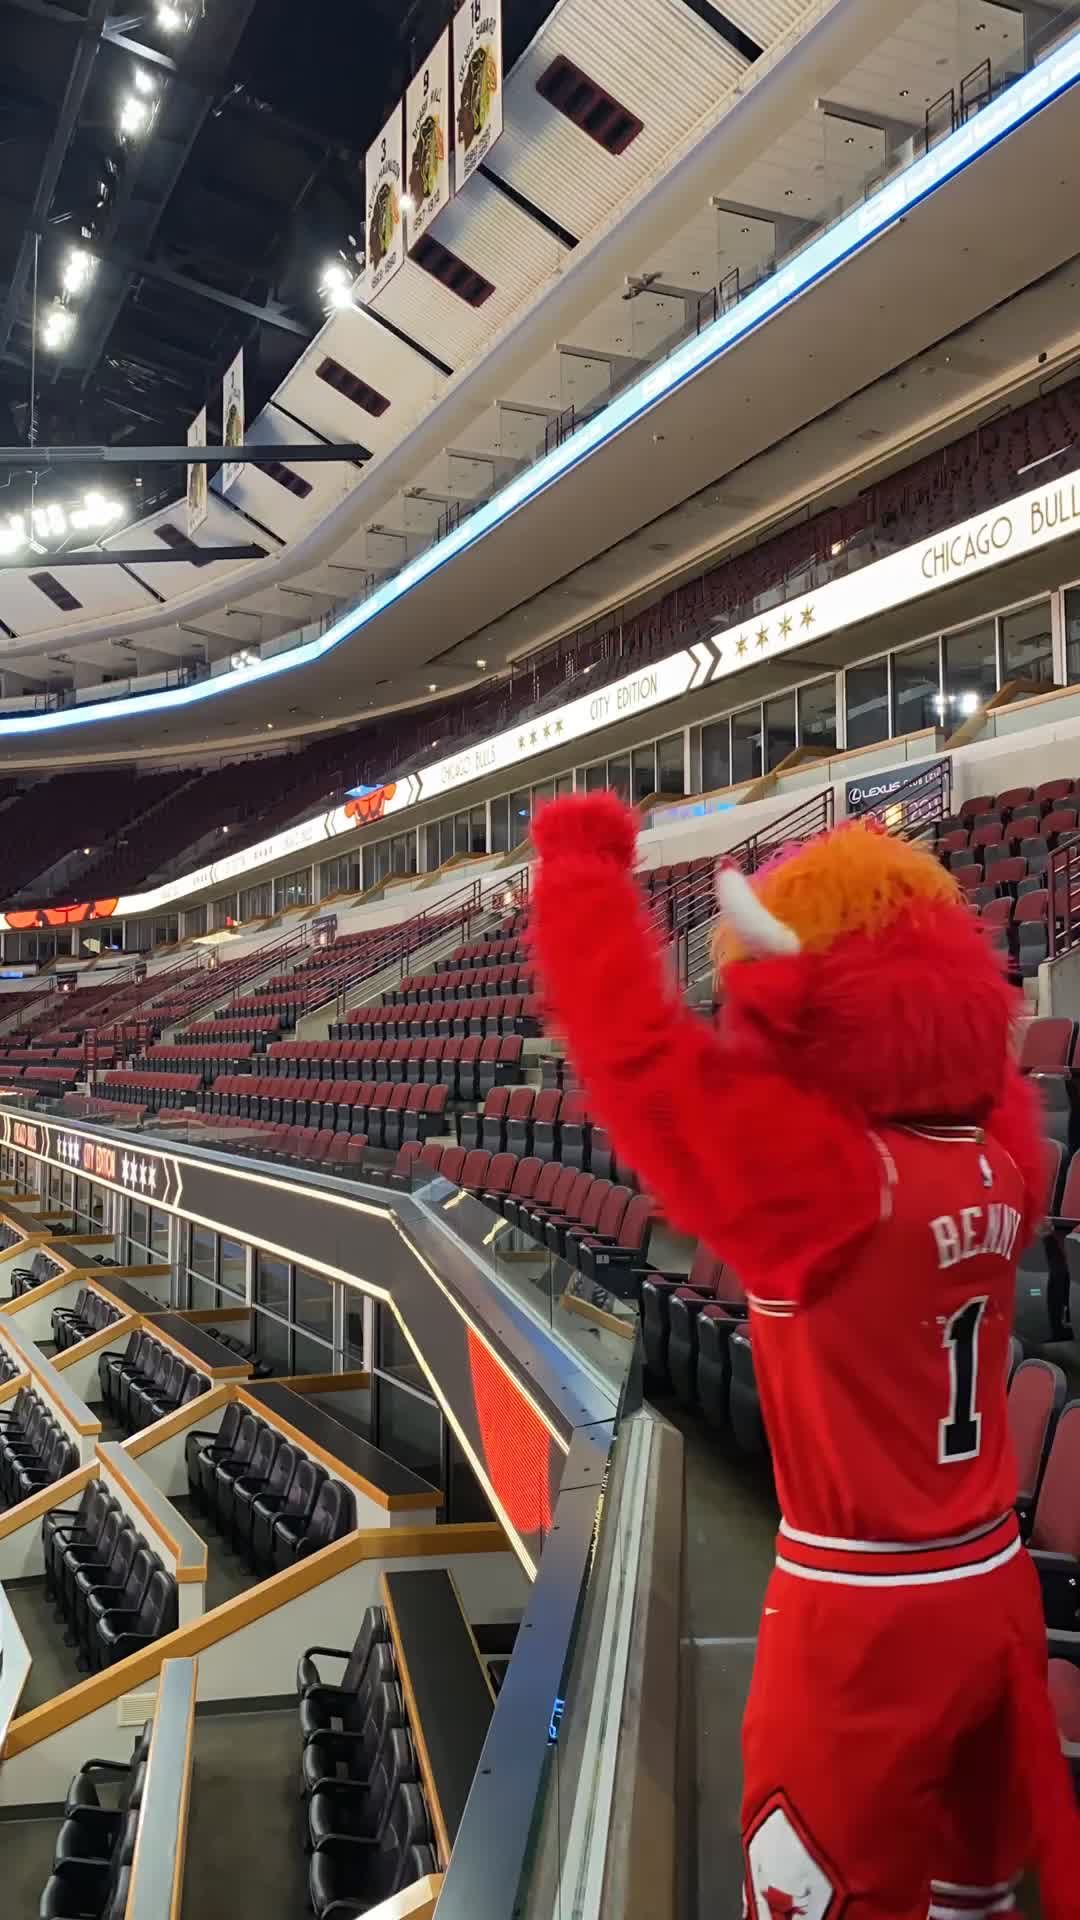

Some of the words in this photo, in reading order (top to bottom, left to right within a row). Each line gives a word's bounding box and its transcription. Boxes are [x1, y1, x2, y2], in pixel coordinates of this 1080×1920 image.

[423, 69, 430, 97] 9
[381, 137, 387, 163] 3
[921, 516, 1023, 578] CHICAGO
[590, 694, 610, 721] CITY
[616, 671, 658, 710] EDITION
[862, 780, 901, 798] LEXUS
[928, 1203, 1021, 1269] BENNY
[937, 1295, 990, 1465] 1
